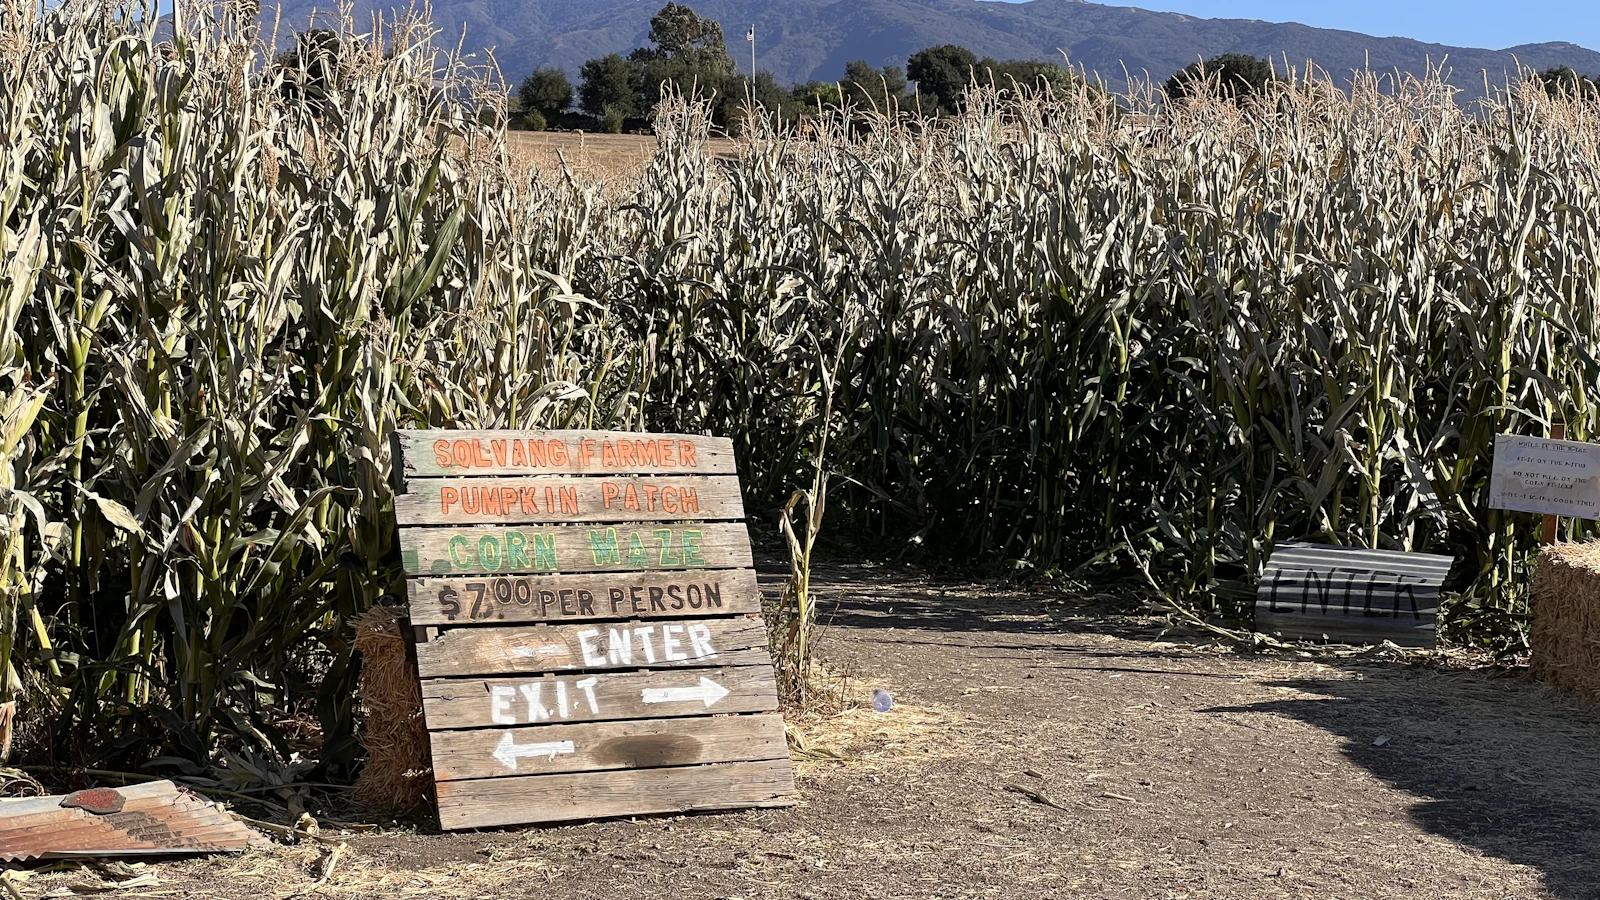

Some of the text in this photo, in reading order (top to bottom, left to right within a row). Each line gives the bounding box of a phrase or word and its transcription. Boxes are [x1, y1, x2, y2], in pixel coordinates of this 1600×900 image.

[433, 438, 697, 468] SOLVANG FARMER
[441, 482, 699, 516] PUMPKIN PATCH
[1554, 497, 1574, 505] GOOD
[448, 527, 706, 571] CORN MAZE
[539, 588, 595, 617] PER
[608, 582, 723, 614] PERSON
[1268, 567, 1427, 621] ENTER
[577, 623, 719, 668] ENTER
[490, 677, 600, 725] EXIT
